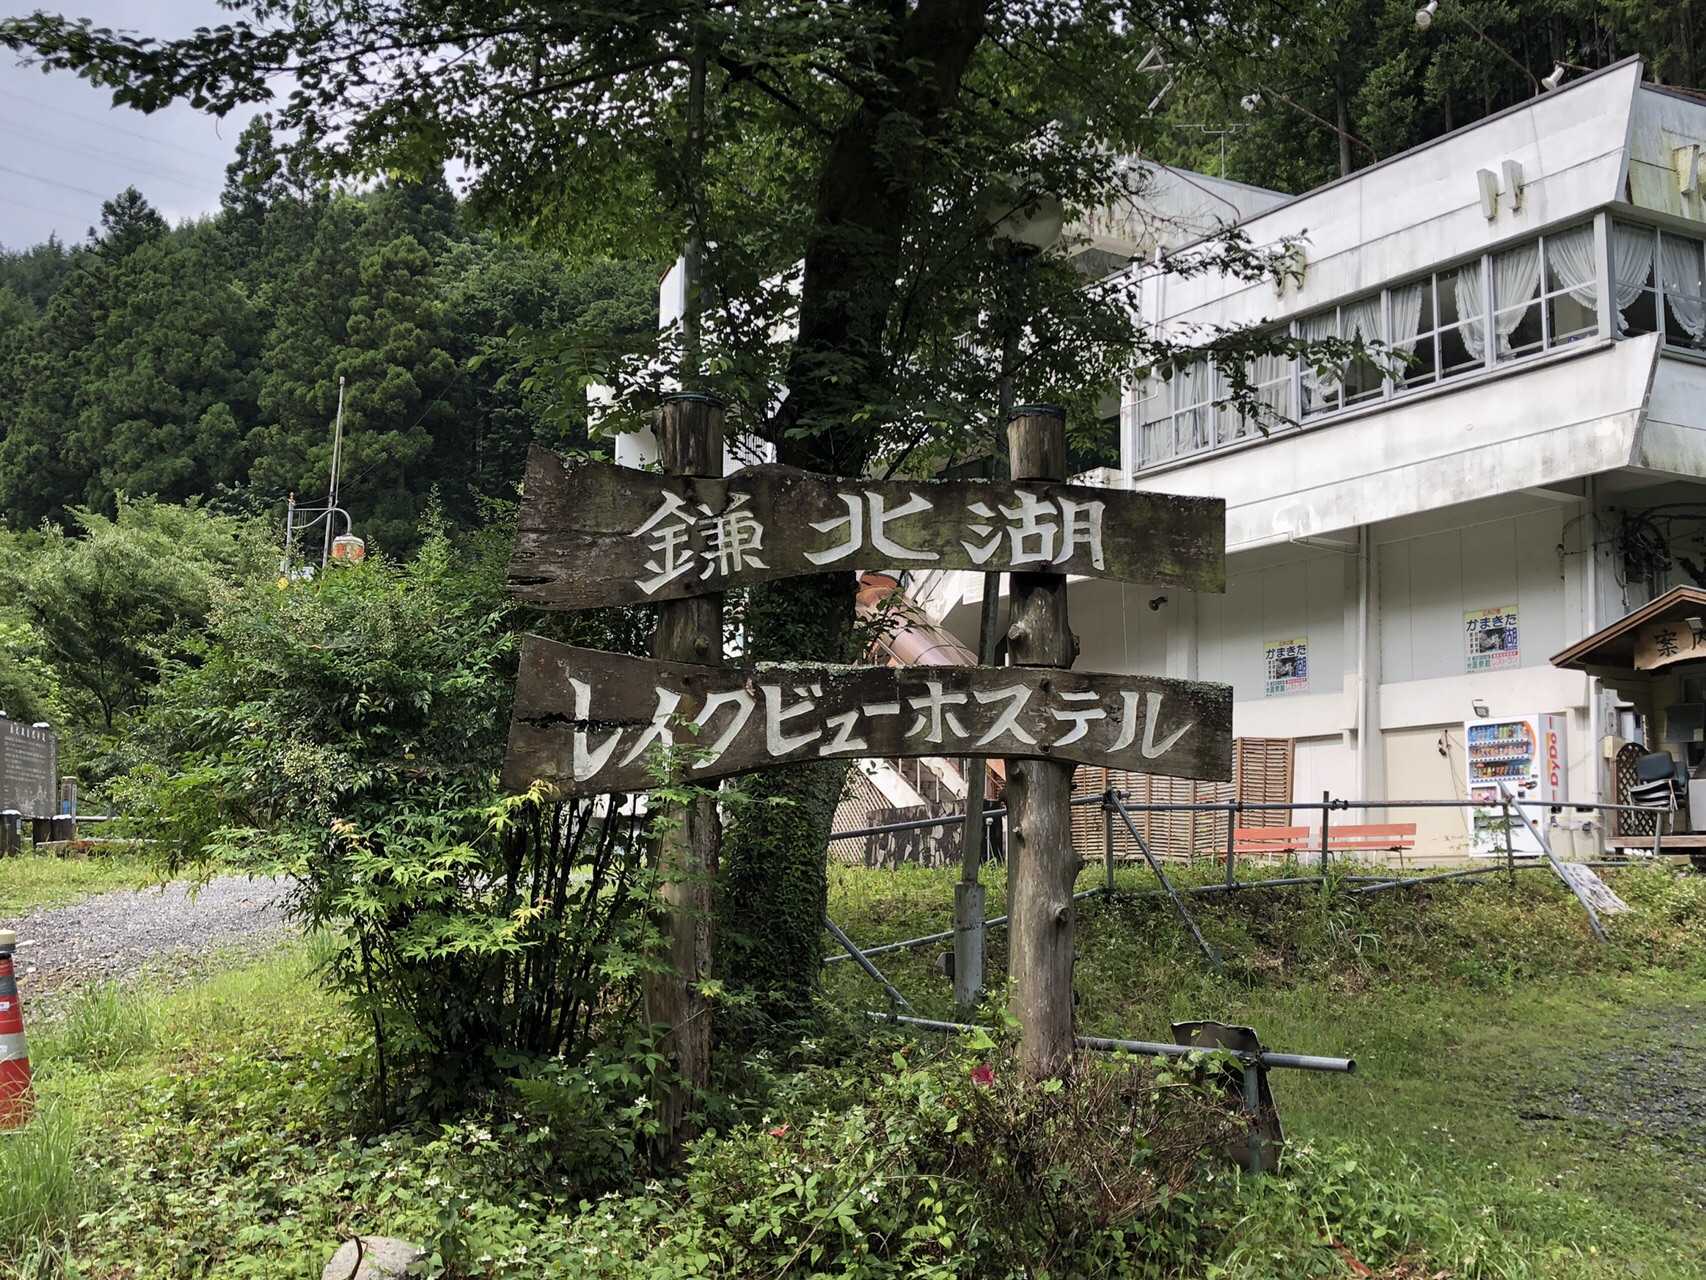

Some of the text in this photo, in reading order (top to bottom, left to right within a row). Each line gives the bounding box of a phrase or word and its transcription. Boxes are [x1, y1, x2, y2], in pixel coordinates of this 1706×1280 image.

[627, 488, 1106, 595] 鎌北湖
[1466, 613, 1517, 631] かまきた
[1266, 645, 1306, 659] かまきた
[568, 677, 1192, 782] レイクビューホステル
[1550, 733, 1560, 786] DyDo
